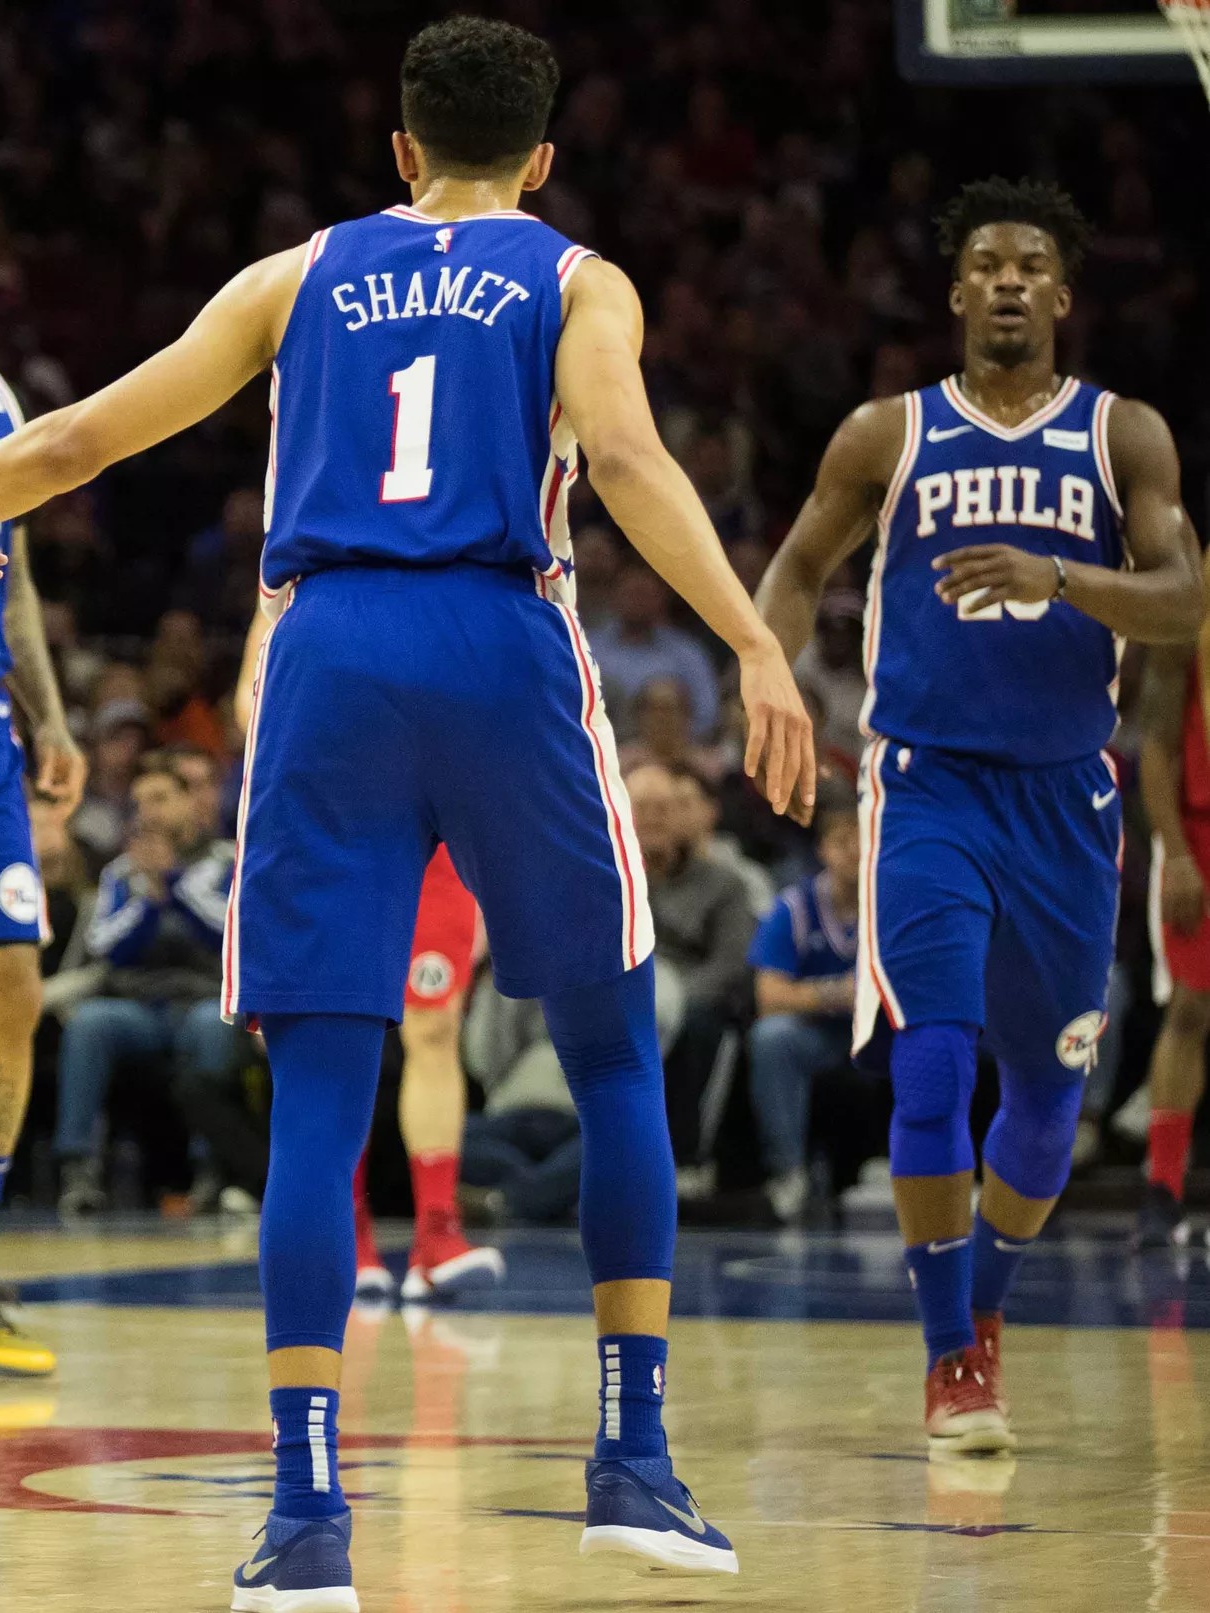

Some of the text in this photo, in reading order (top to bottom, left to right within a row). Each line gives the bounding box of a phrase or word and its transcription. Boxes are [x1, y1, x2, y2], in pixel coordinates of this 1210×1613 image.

[332, 266, 530, 331] SHAMET
[379, 354, 436, 504] 1
[915, 465, 1096, 542] PHILA
